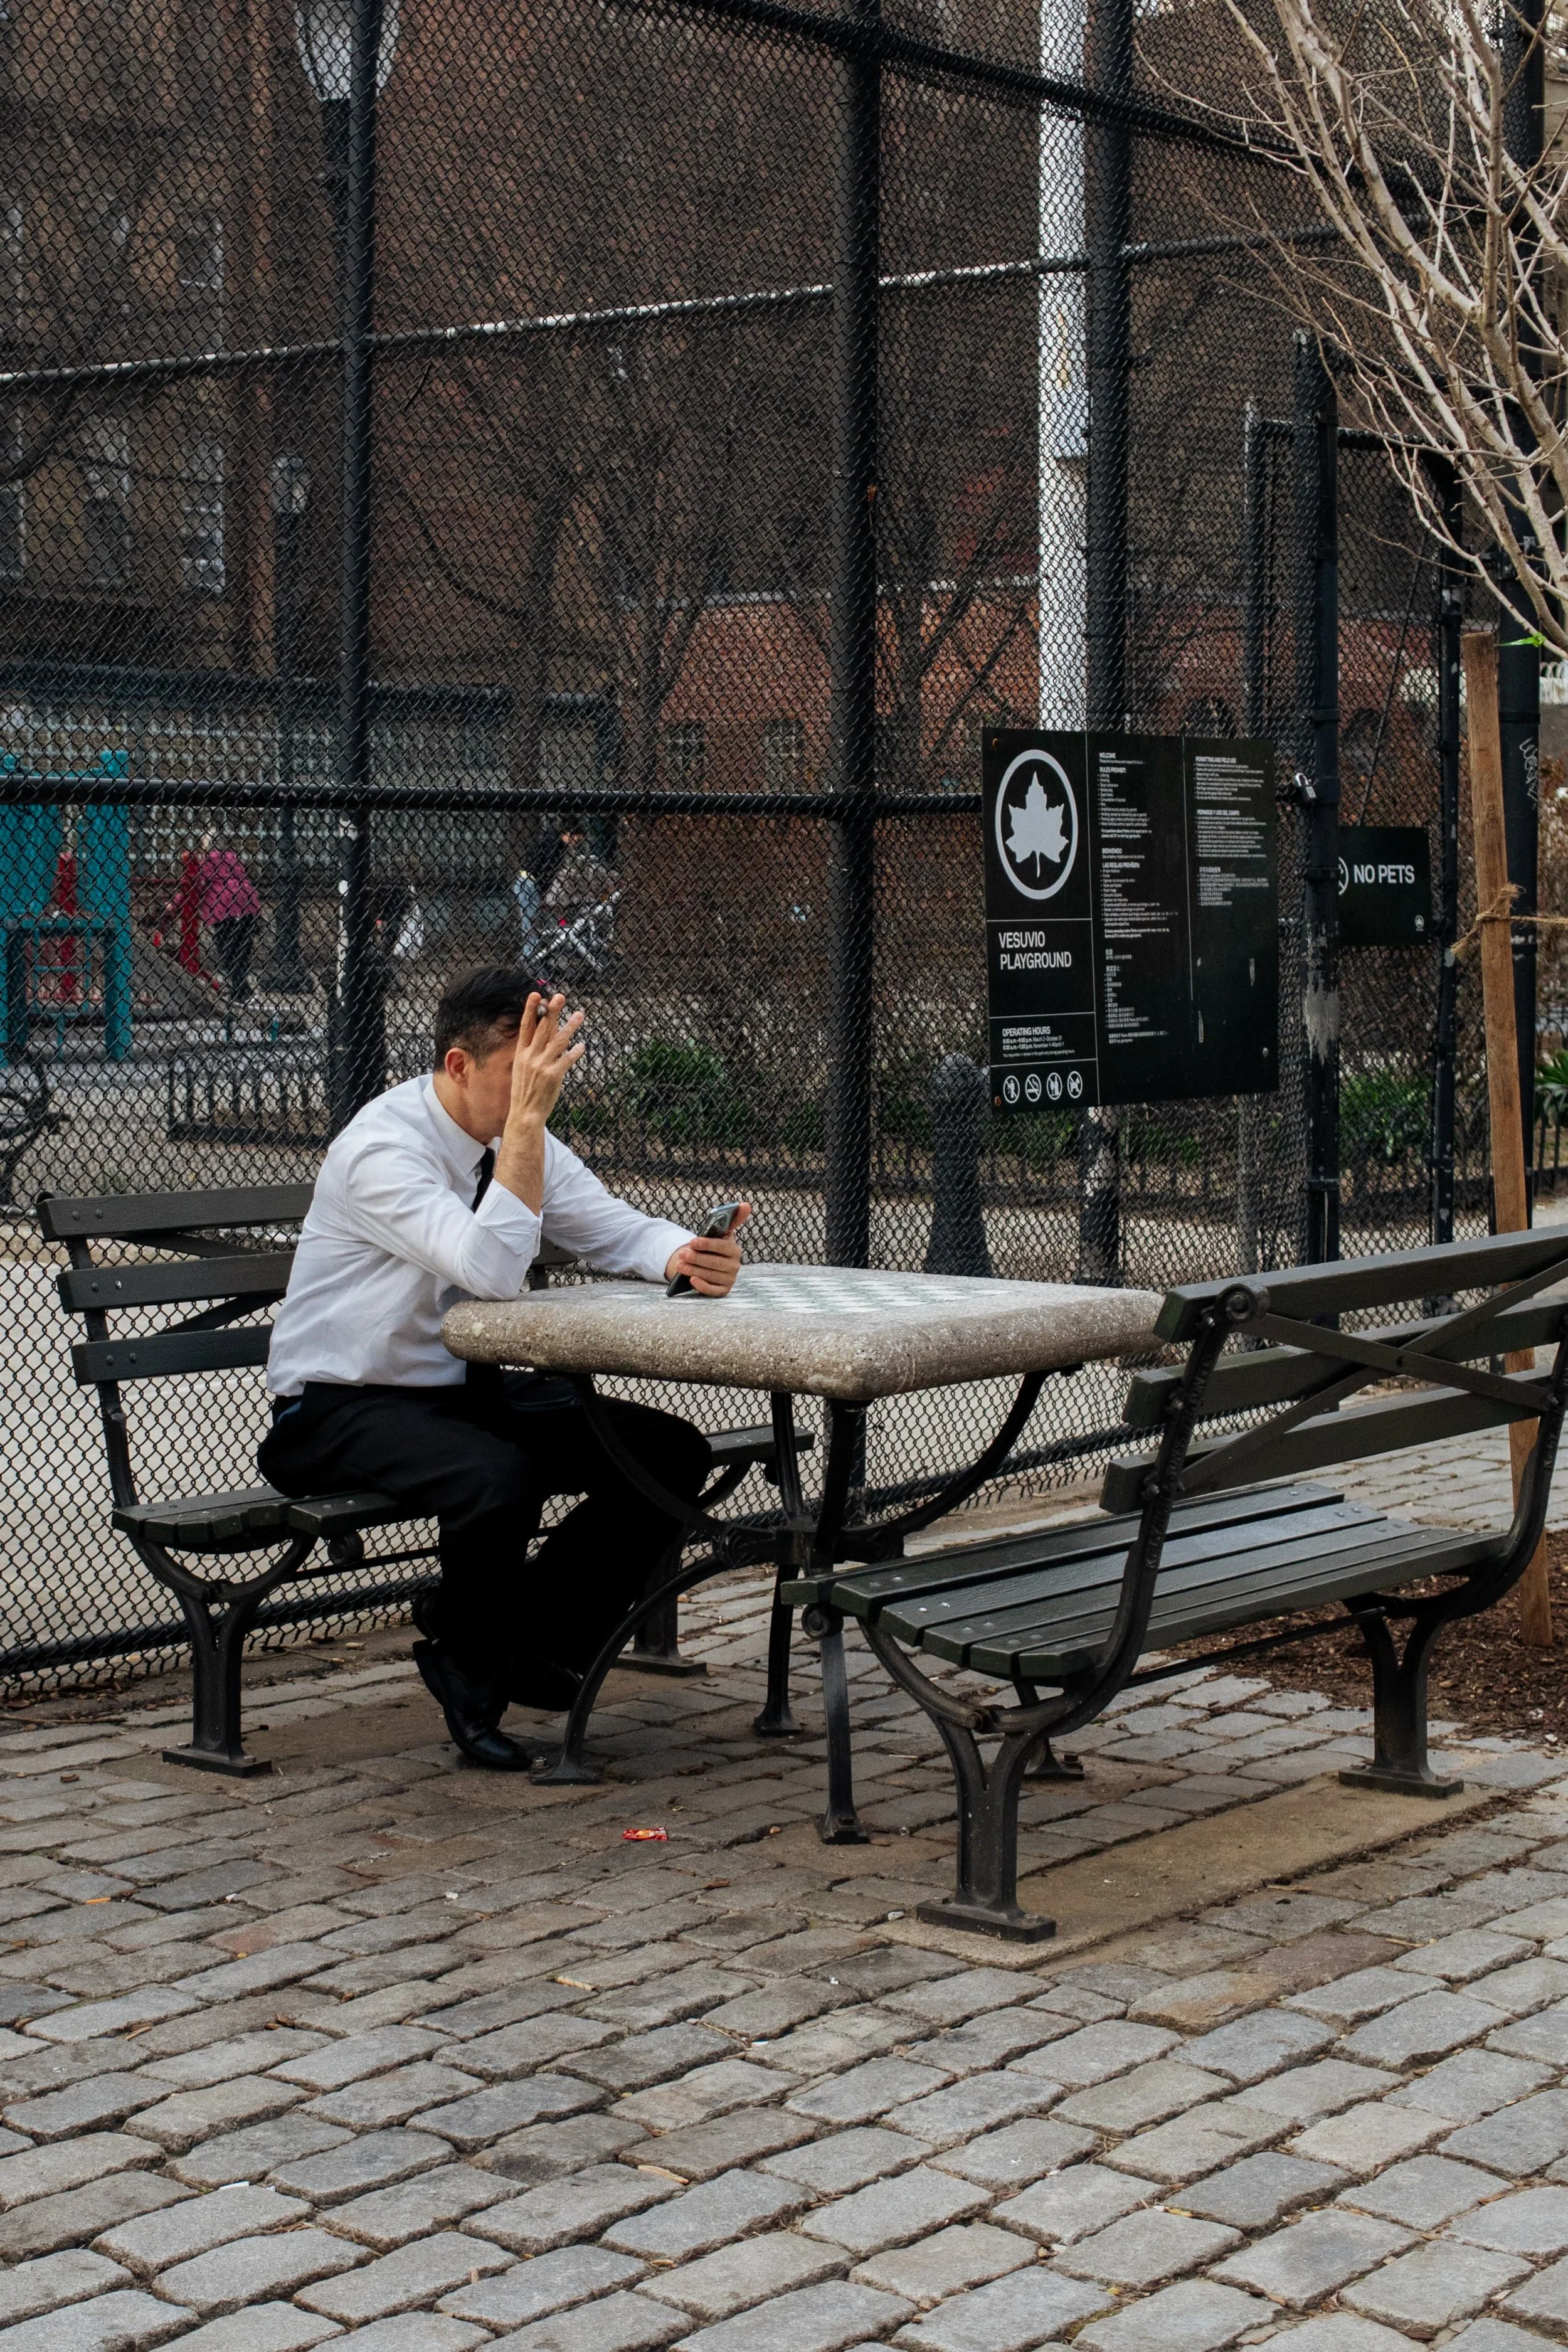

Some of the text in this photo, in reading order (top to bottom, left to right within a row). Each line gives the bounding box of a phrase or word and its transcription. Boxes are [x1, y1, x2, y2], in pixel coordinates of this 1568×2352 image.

[1353, 864, 1415, 884] NO PETS
[999, 931, 1046, 948] VESUVIO
[1000, 951, 1072, 970] PLAYGROUND
[1002, 1026, 1051, 1036] OPERATING HOURS
